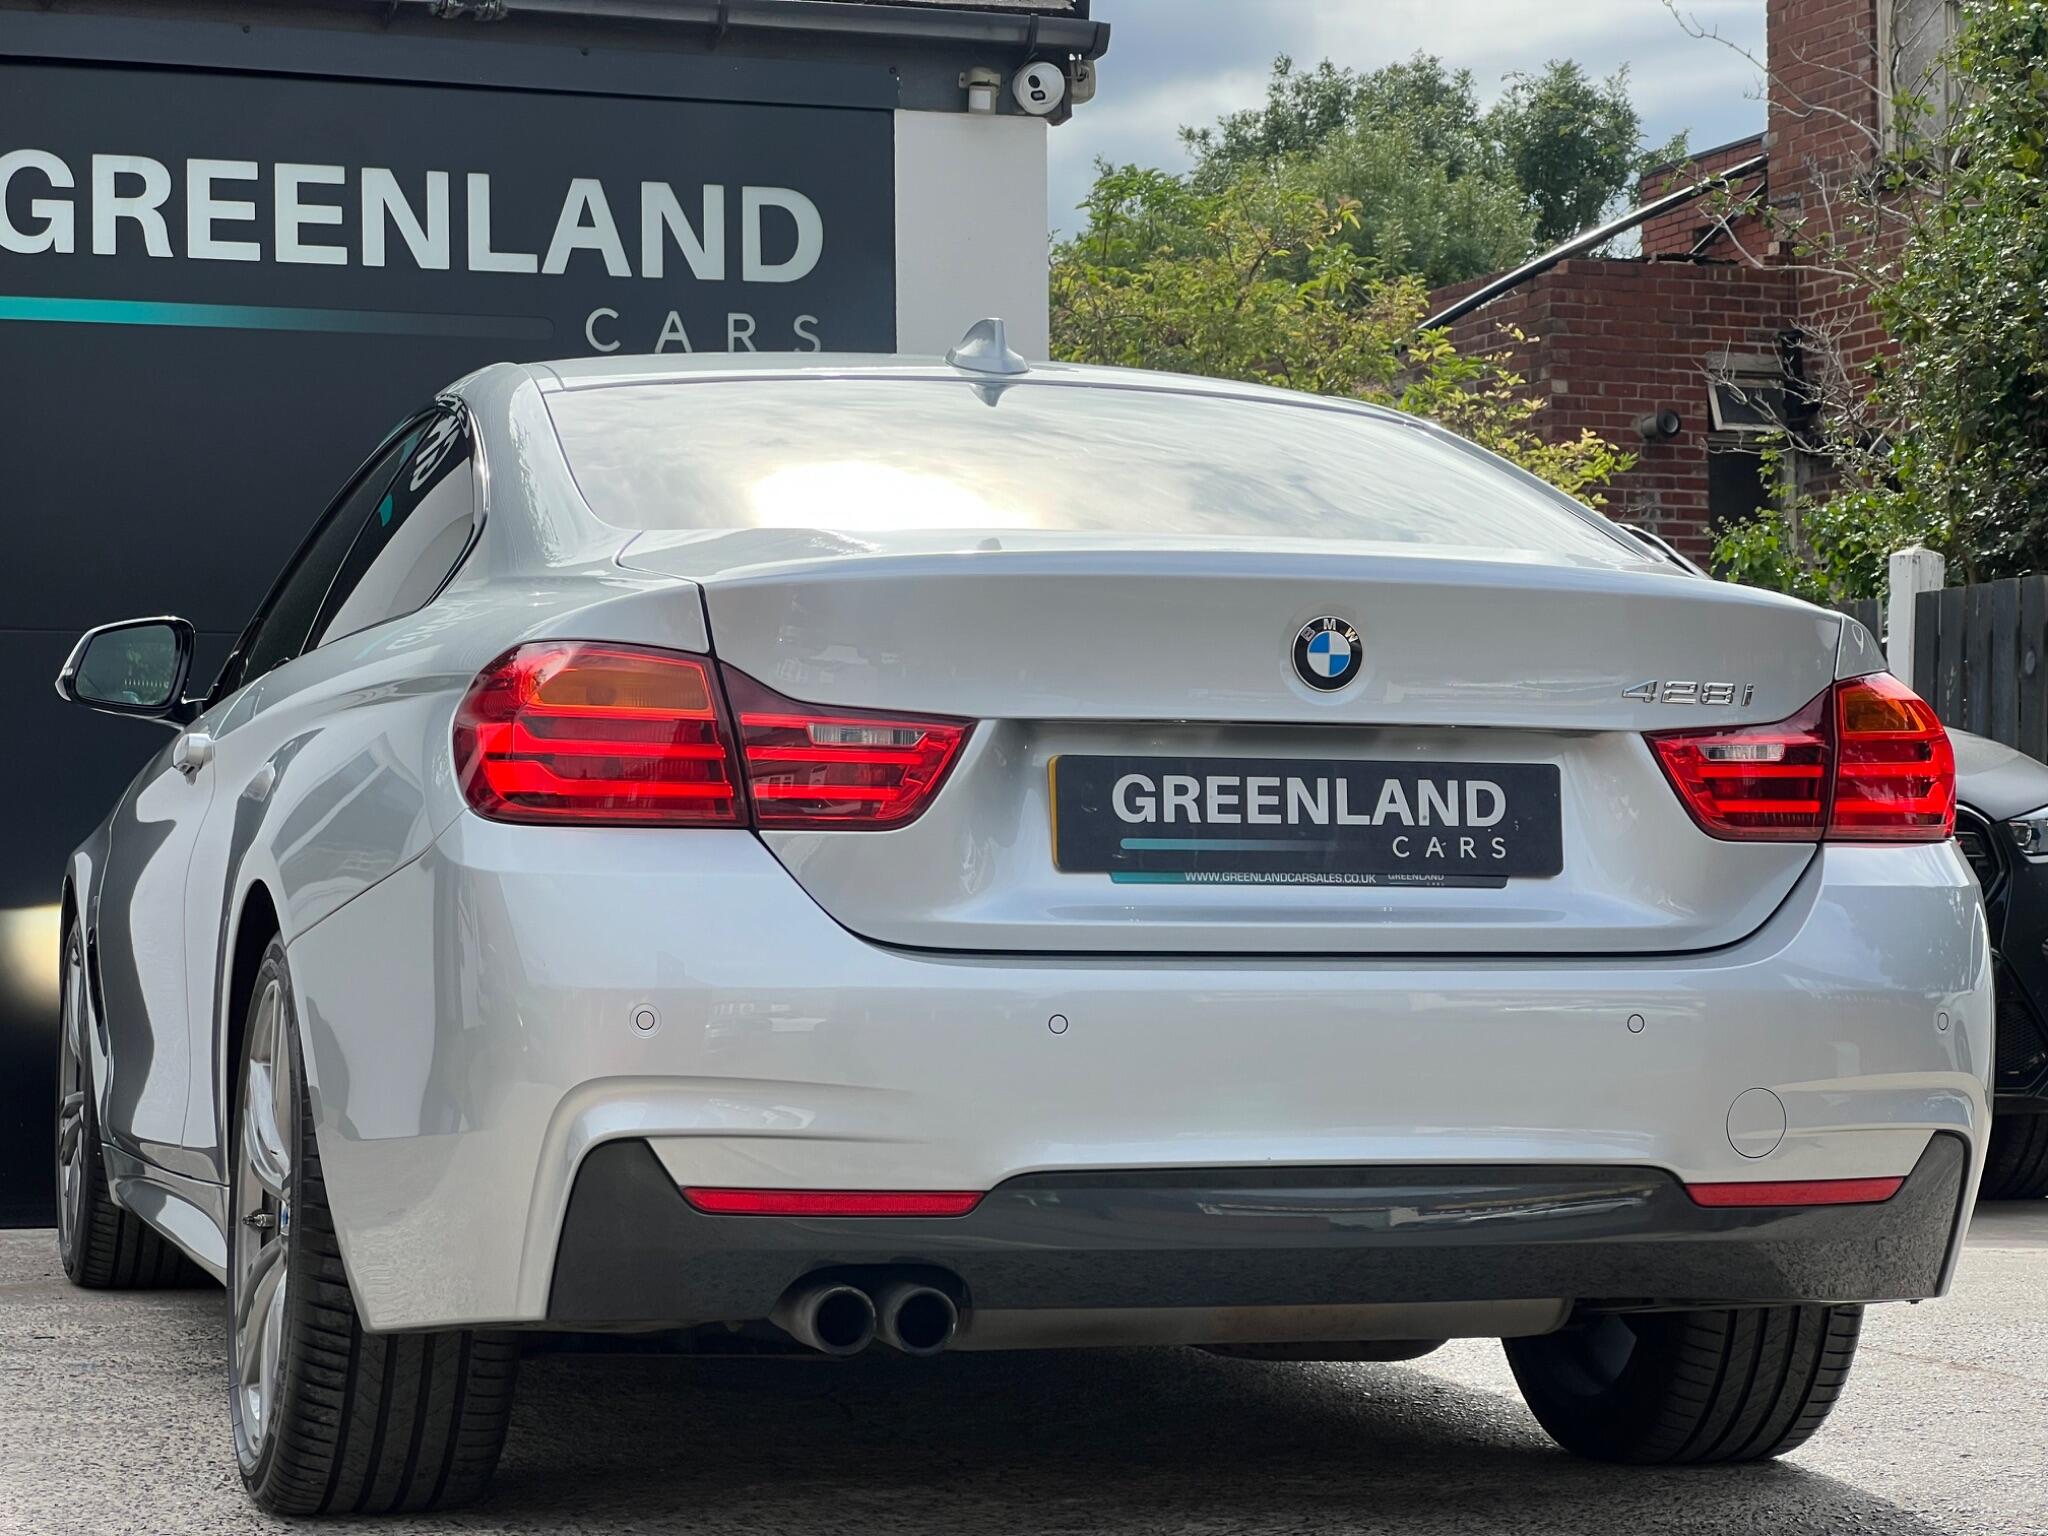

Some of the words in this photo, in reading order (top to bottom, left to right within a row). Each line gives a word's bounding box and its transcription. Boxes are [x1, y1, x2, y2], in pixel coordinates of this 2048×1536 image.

[0, 148, 824, 283] GREENLAND
[585, 307, 822, 353] CARS
[1301, 618, 1359, 642] BMW
[1622, 679, 1754, 706] 428i
[1112, 773, 1507, 827] GREENLAND
[1392, 836, 1507, 858] CARS
[1184, 872, 1376, 884] WWW.GREENLANDCARSALES.CO.UK
